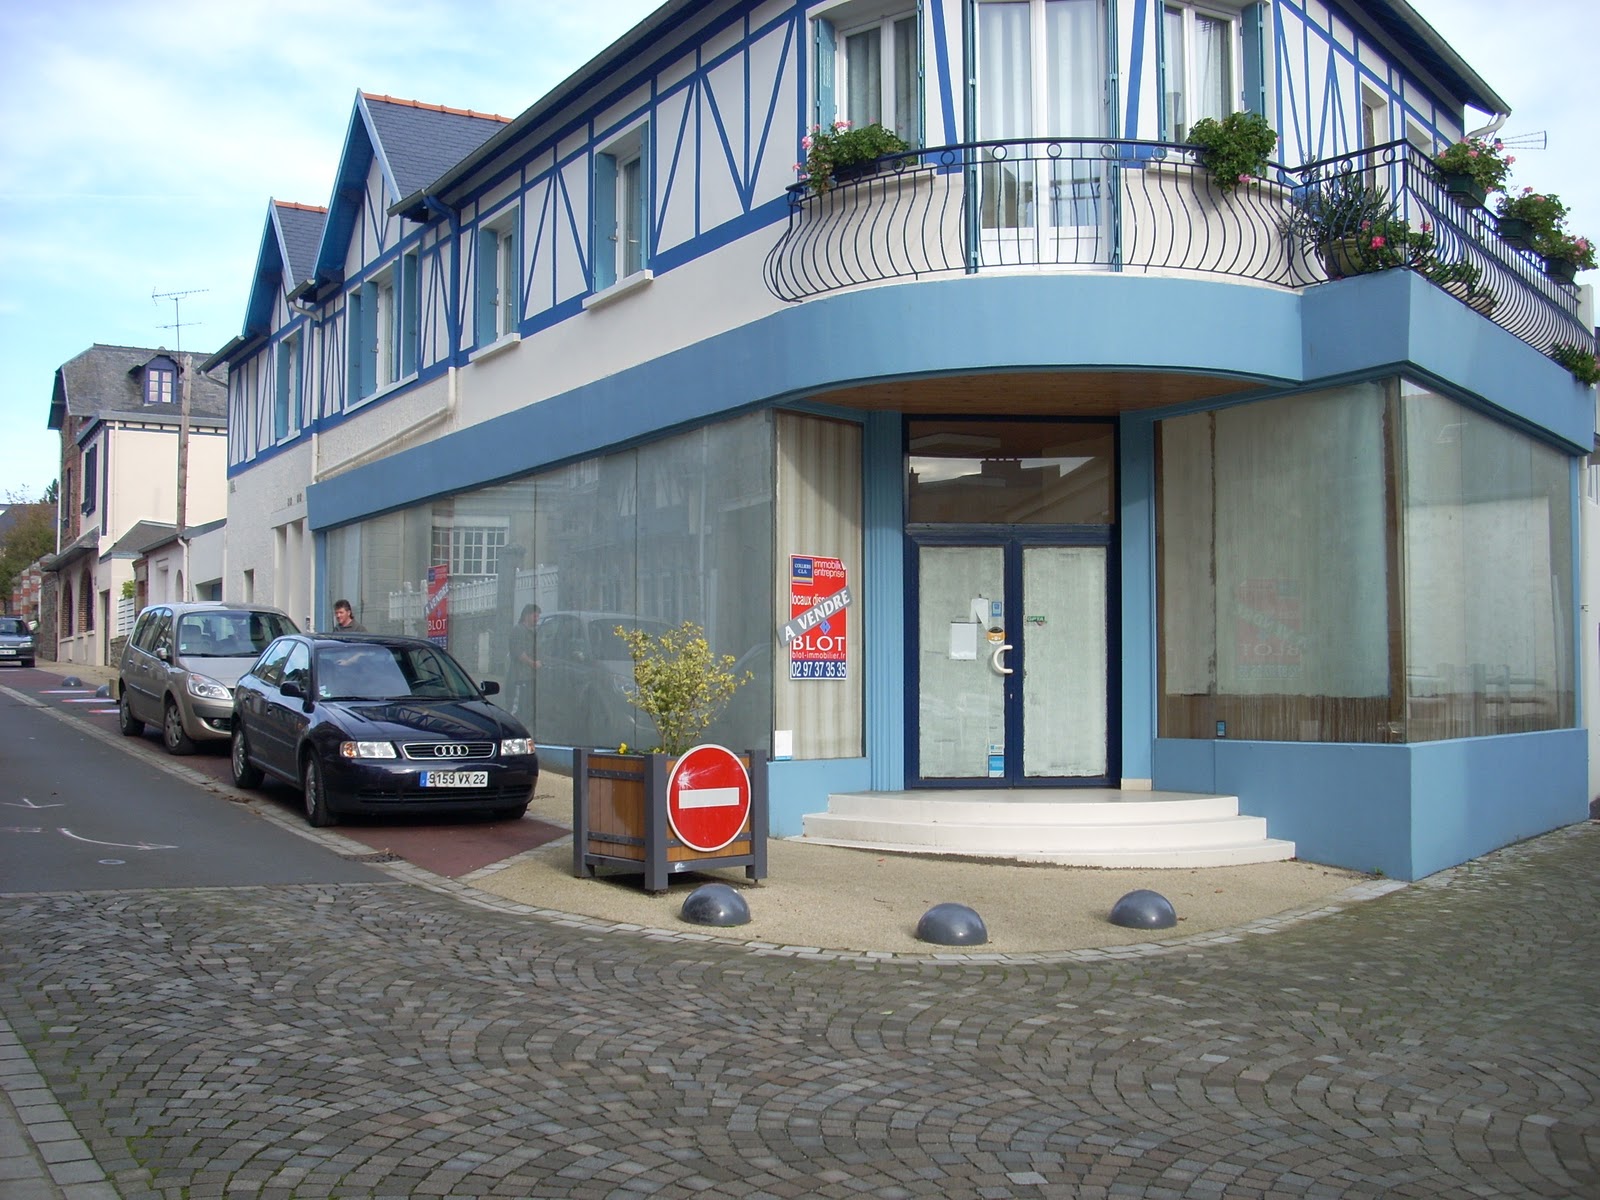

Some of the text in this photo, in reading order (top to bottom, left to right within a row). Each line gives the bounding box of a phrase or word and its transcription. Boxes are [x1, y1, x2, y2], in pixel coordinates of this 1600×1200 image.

[814, 568, 845, 579] entreprise
[792, 592, 812, 606] locaux
[784, 625, 796, 642] A
[797, 590, 851, 630] VENDRE
[428, 618, 447, 631] BLOT
[793, 635, 845, 651] BLOT
[792, 651, 846, 660] blot-immobilier.fr
[792, 661, 846, 677] 02 97 37 35 35
[428, 773, 487, 785] 9159 VX 22
